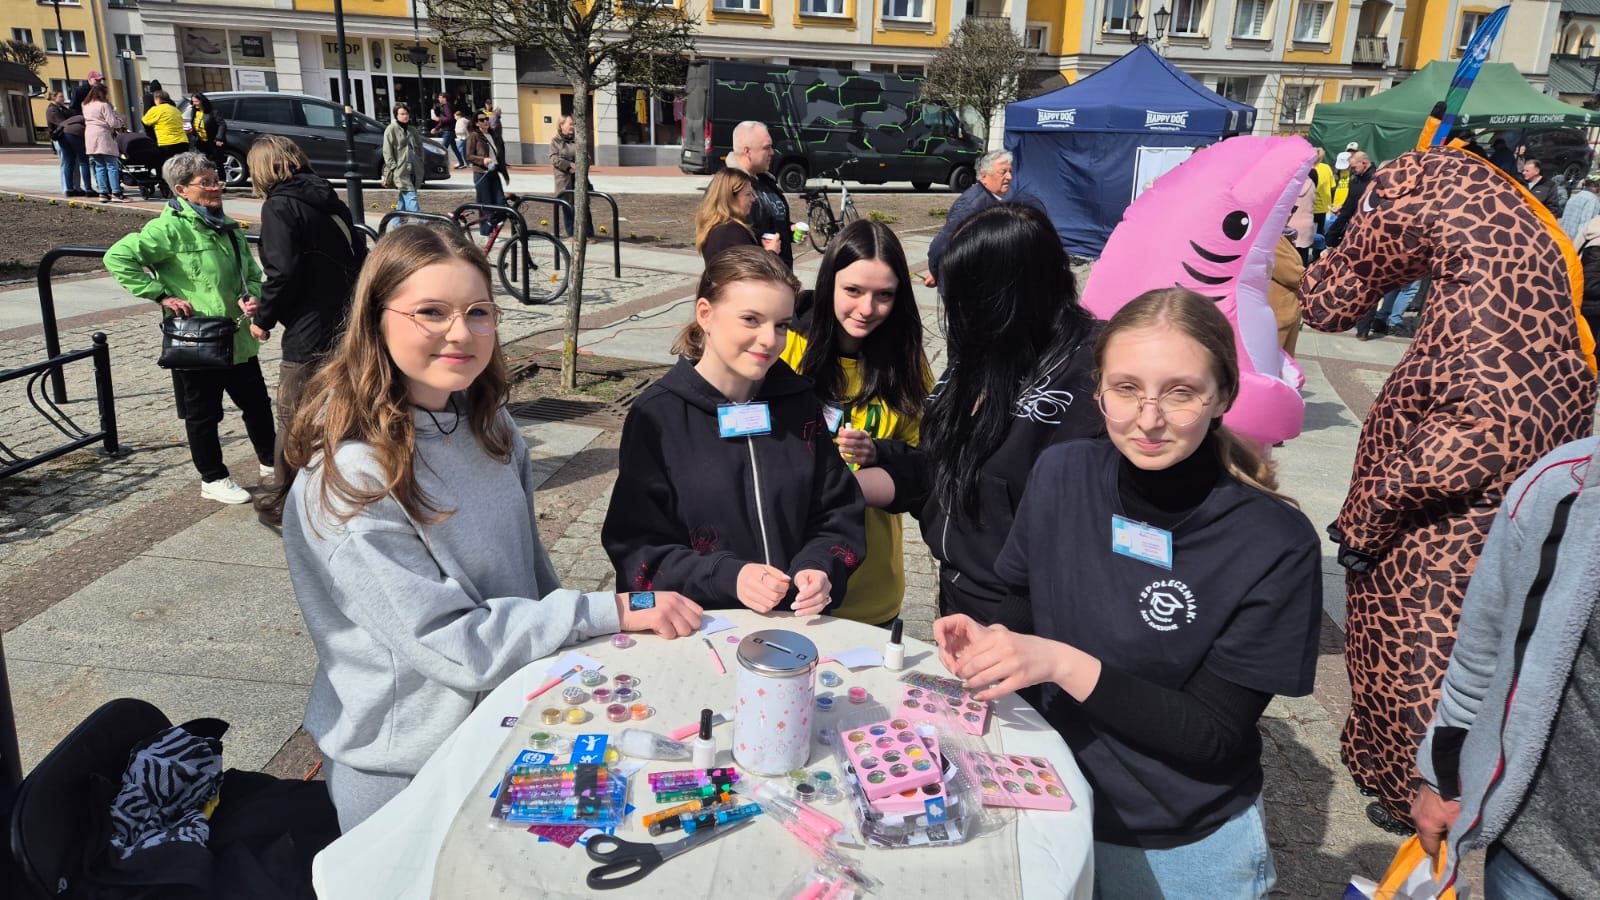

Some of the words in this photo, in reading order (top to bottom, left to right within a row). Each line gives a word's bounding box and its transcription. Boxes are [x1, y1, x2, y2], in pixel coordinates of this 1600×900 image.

[394, 53, 437, 63] OBE
[1038, 111, 1060, 121] HAPPY
[1060, 111, 1076, 122] DOG
[1146, 112, 1170, 124] HAPPY
[1170, 113, 1188, 125] DOG
[1141, 580, 1197, 619] SPOŁECZNIAK
